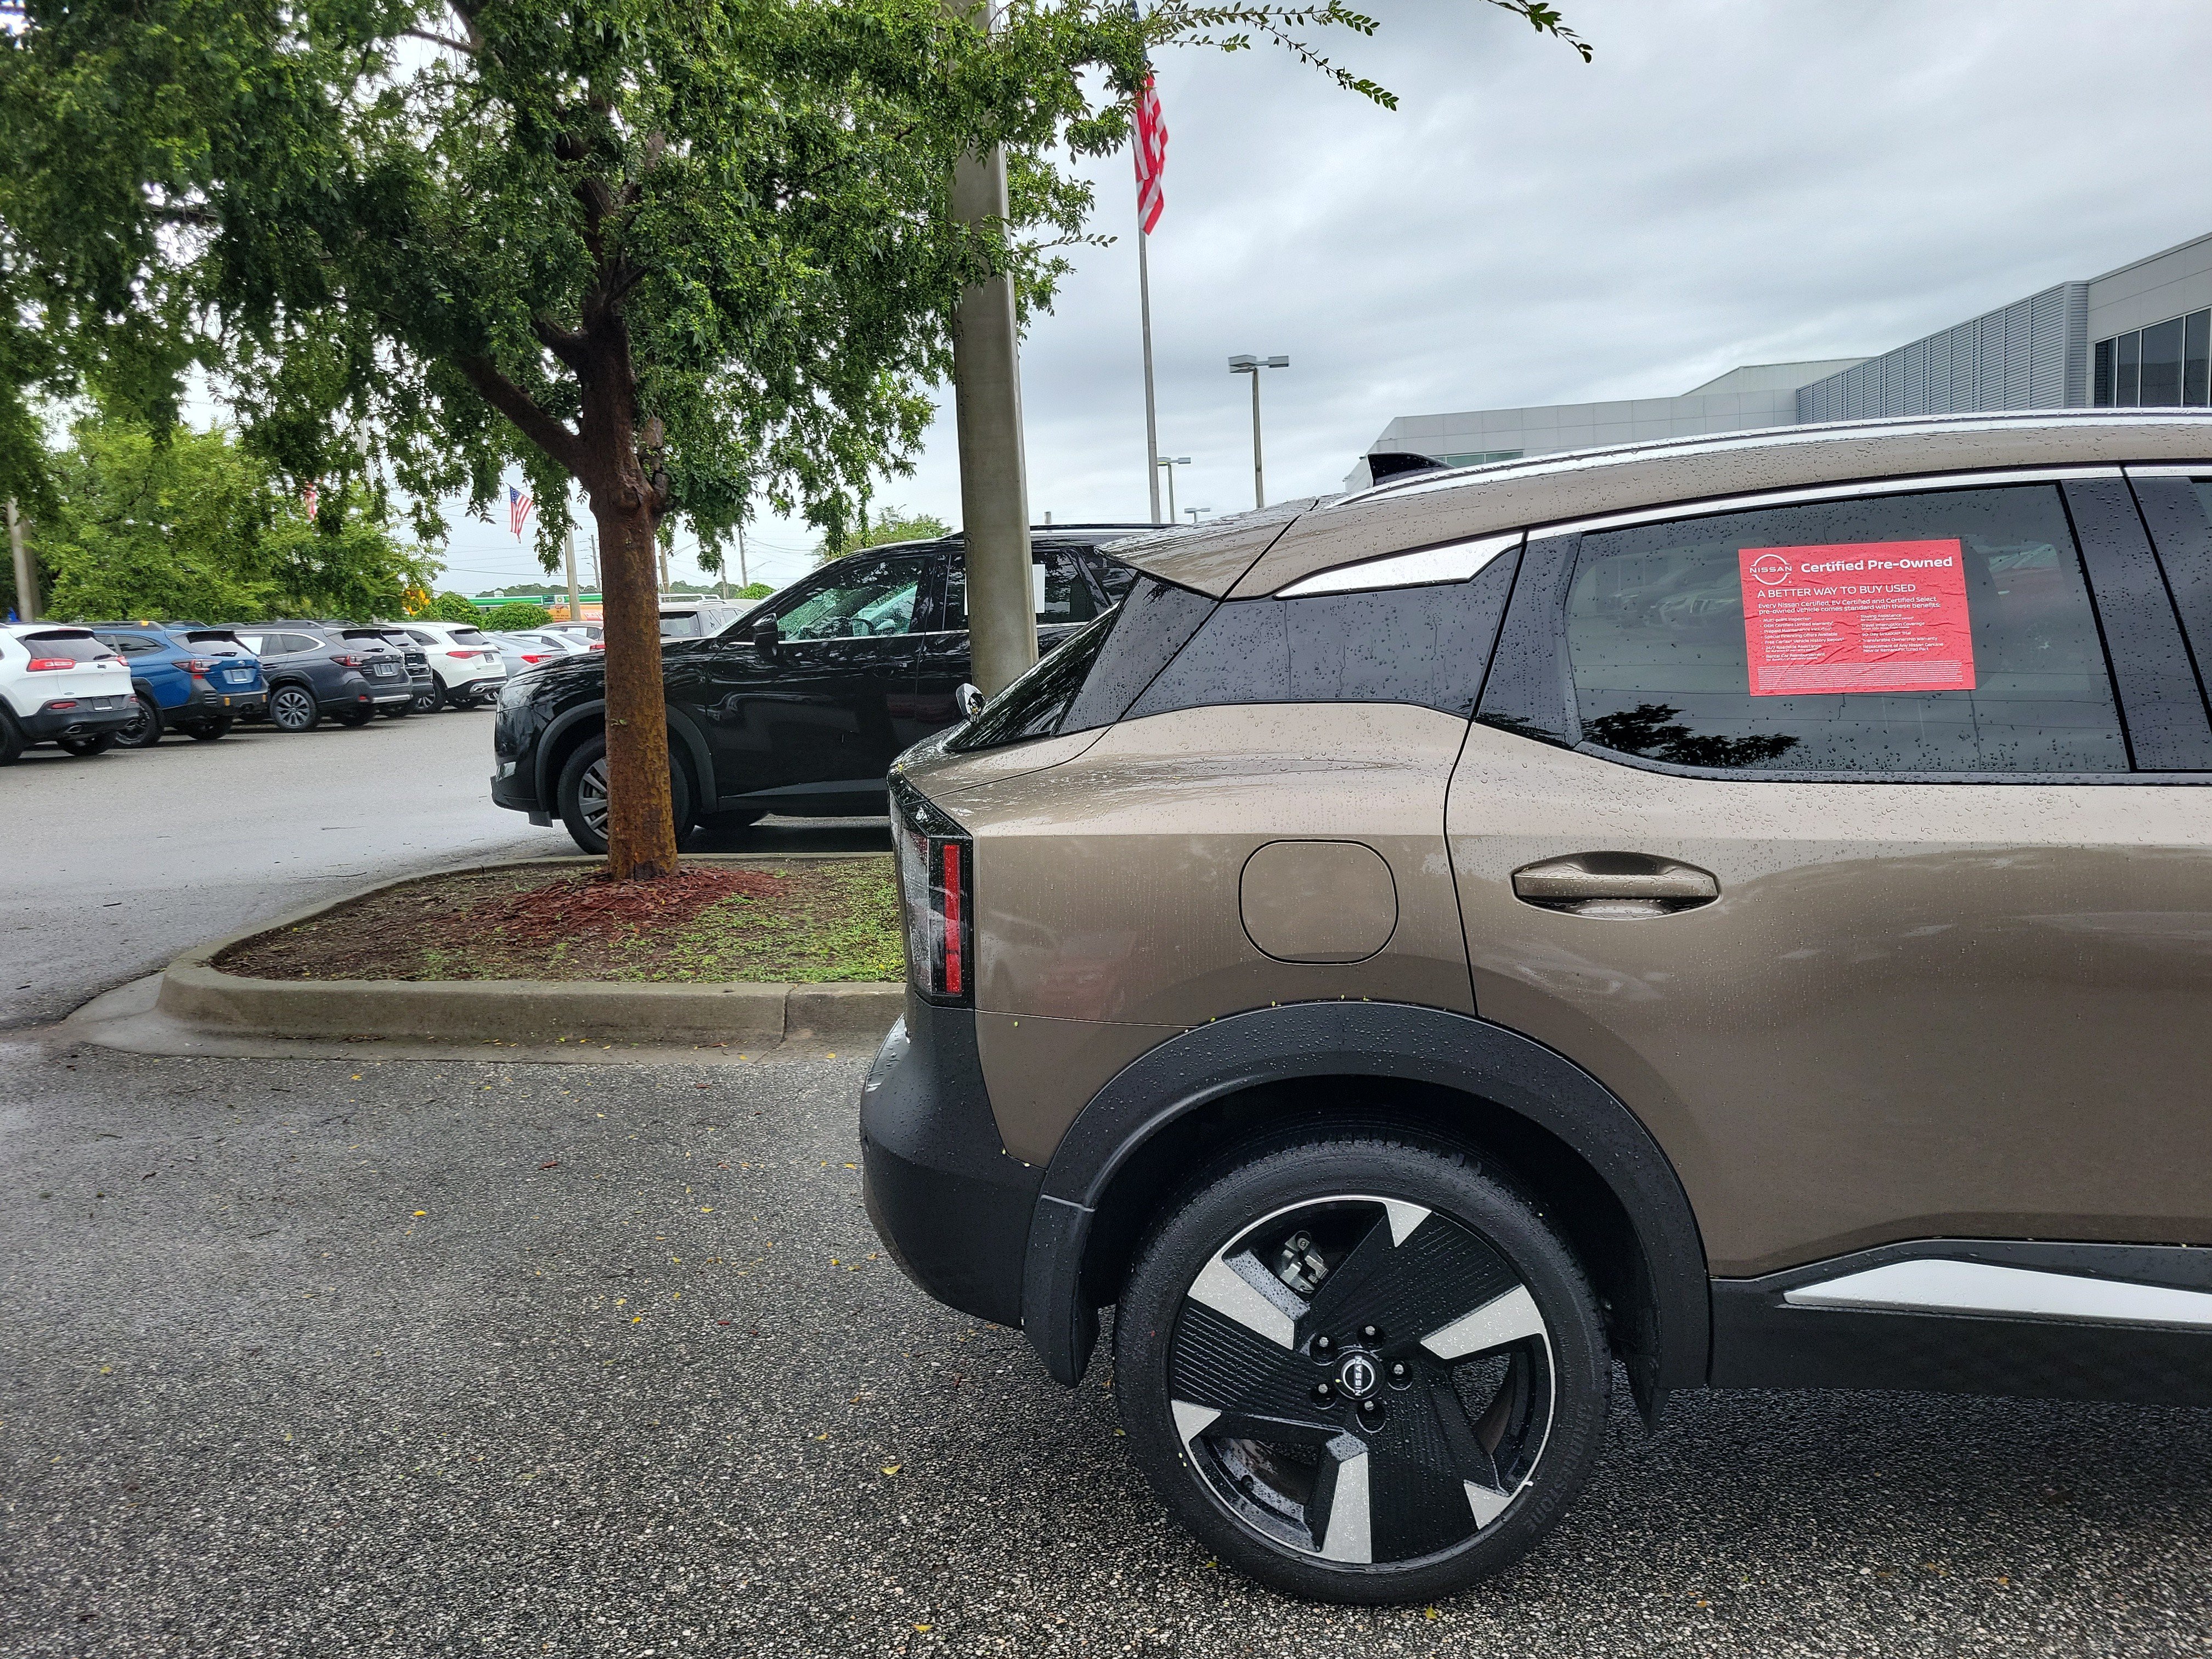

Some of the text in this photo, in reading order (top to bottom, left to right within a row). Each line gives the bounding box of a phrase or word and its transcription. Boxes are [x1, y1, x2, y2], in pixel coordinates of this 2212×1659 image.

[1801, 556, 1953, 573] Certified Pre-Owned
[1757, 584, 1916, 598] A BETTER WAY TO BUY USED
[1355, 1356, 1363, 1396] NISSAN
